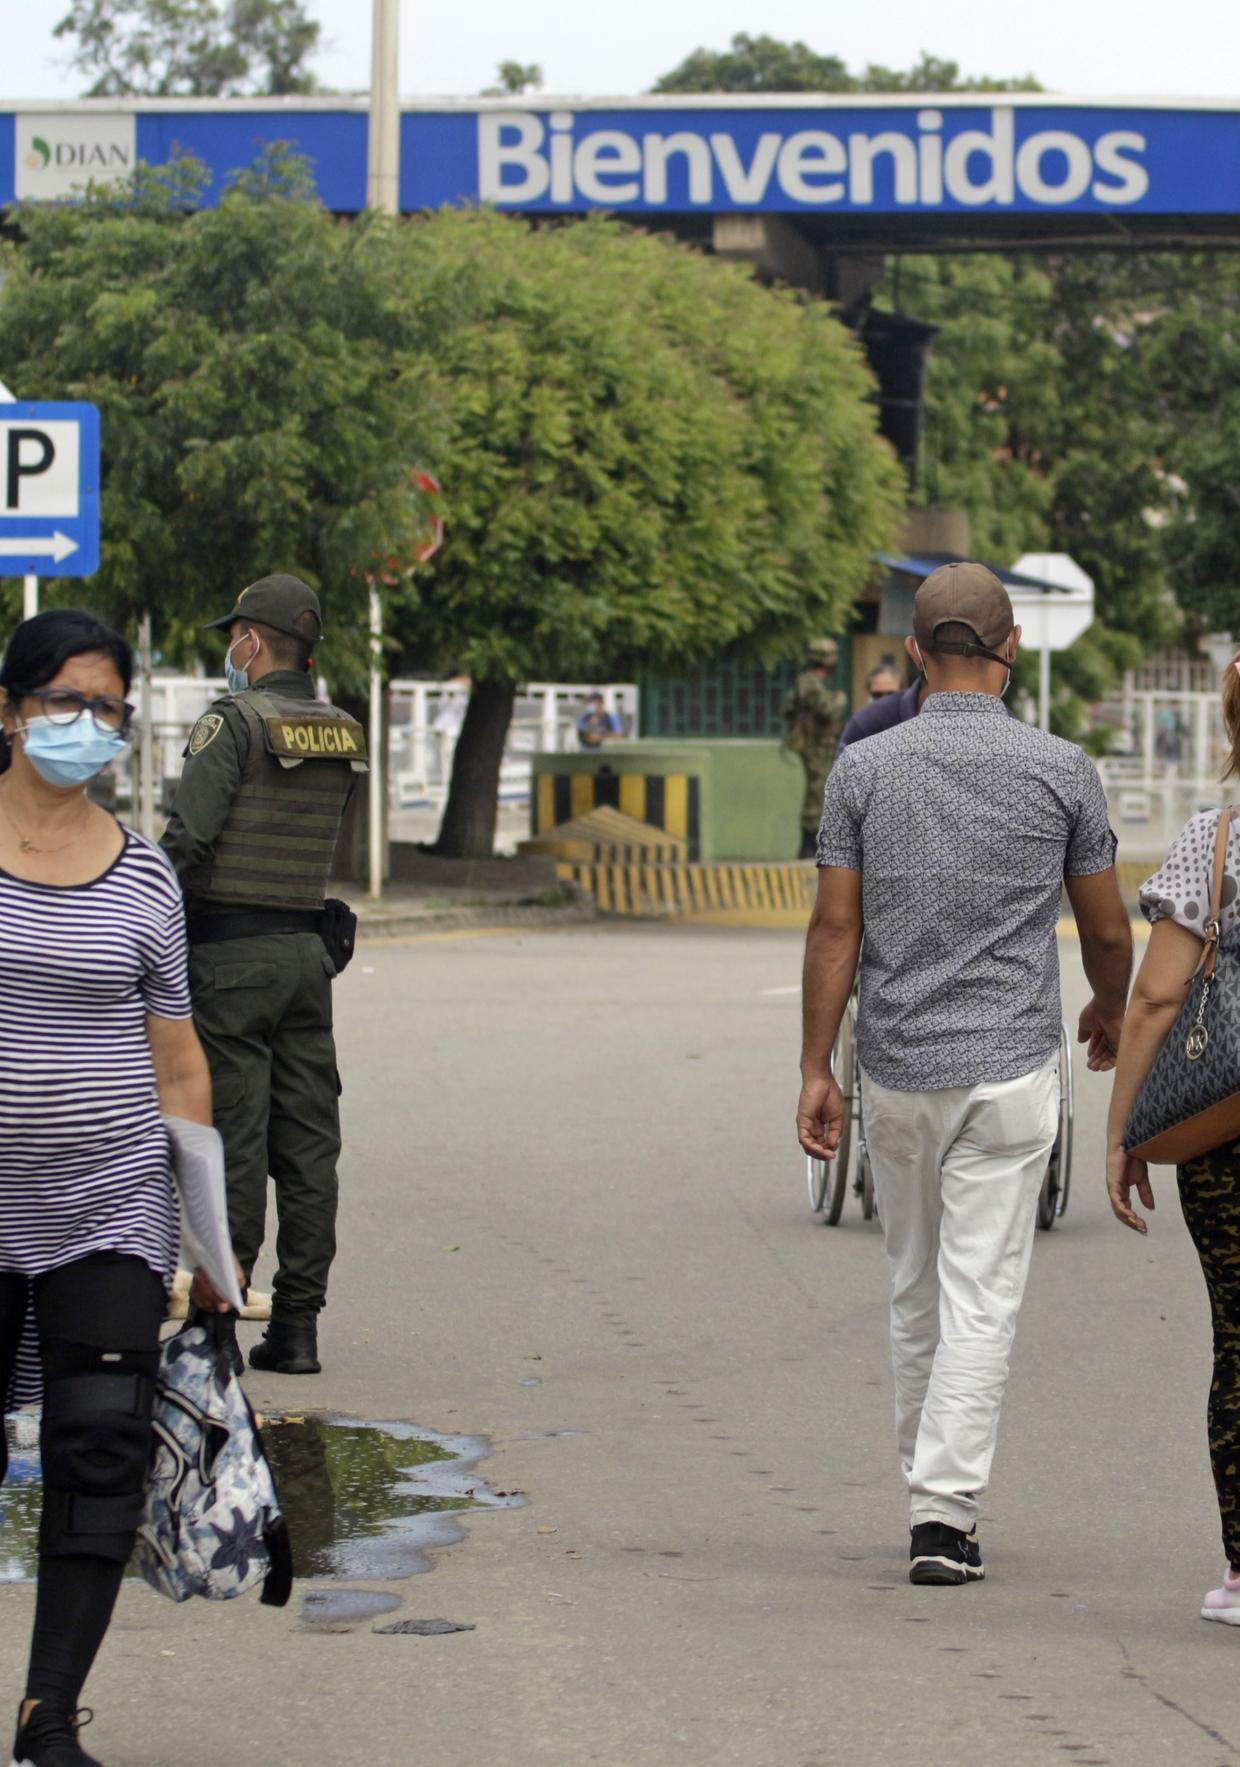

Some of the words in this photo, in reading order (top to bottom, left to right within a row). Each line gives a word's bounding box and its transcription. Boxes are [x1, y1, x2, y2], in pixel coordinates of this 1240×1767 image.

[55, 143, 130, 168] DIAN
[477, 108, 1149, 206] Bienvenidos
[6, 427, 56, 509] P
[281, 724, 358, 753] POLICIA
